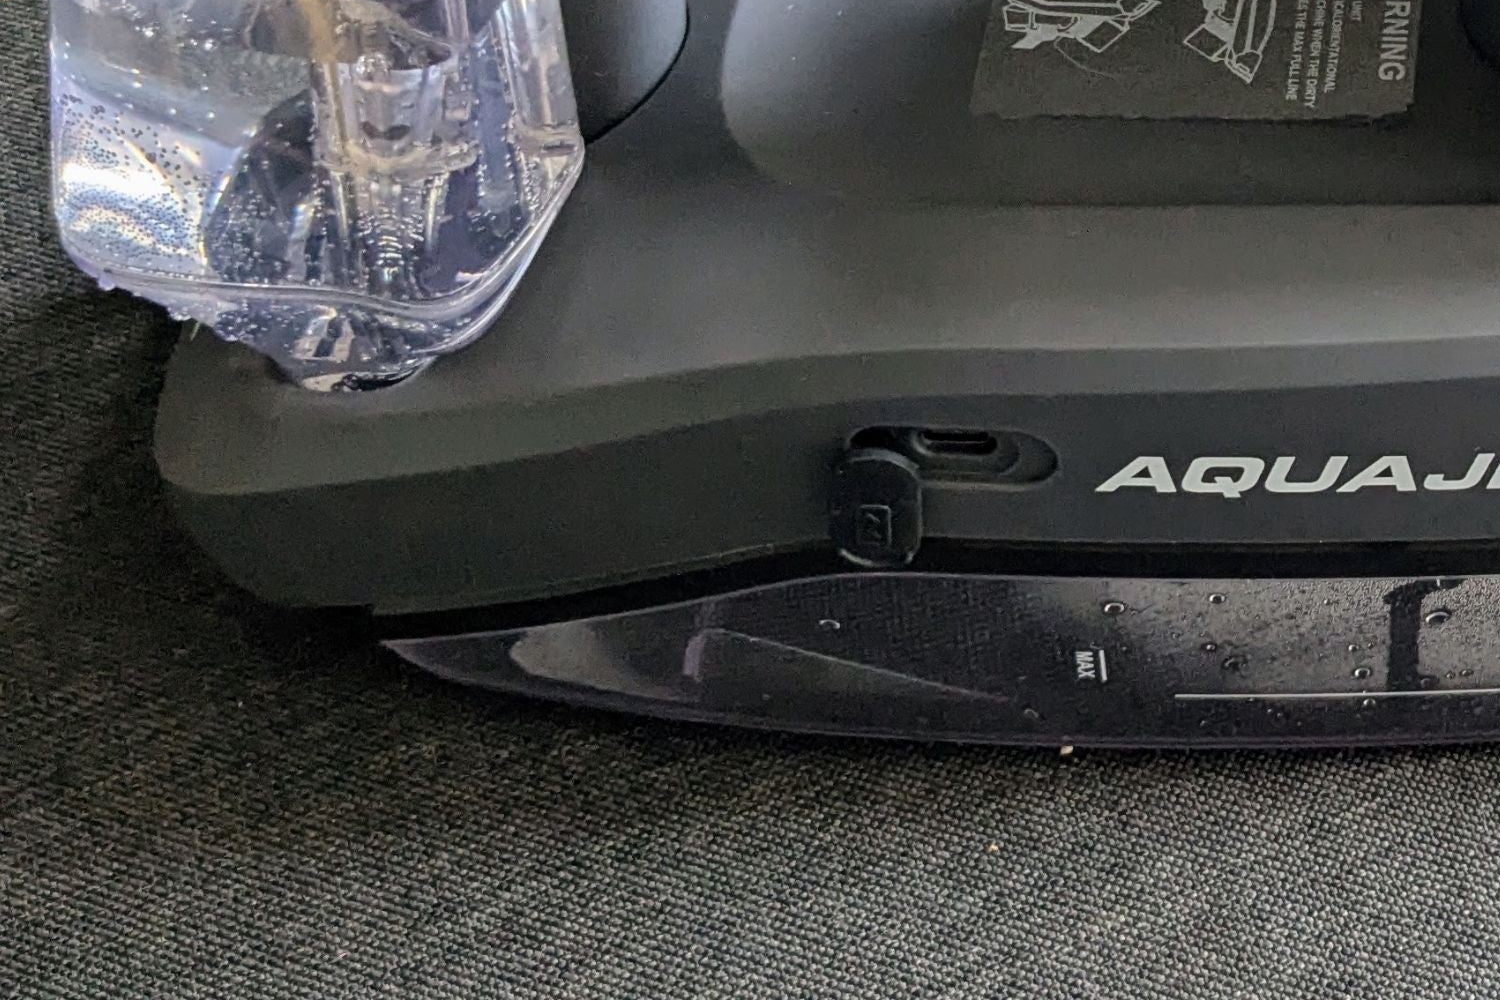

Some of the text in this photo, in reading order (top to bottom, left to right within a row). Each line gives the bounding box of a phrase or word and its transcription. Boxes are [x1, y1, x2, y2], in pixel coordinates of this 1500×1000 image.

[1296, 11, 1307, 28] THE
[1351, 0, 1362, 21] UNIT
[1293, 31, 1304, 51] MAX
[1311, 29, 1323, 56] WHEN
[1289, 54, 1301, 76] FULL
[1308, 59, 1319, 76] THE
[1286, 78, 1299, 99] LINE
[1304, 78, 1317, 107] DIRTY
[1075, 651, 1096, 678] MAX
